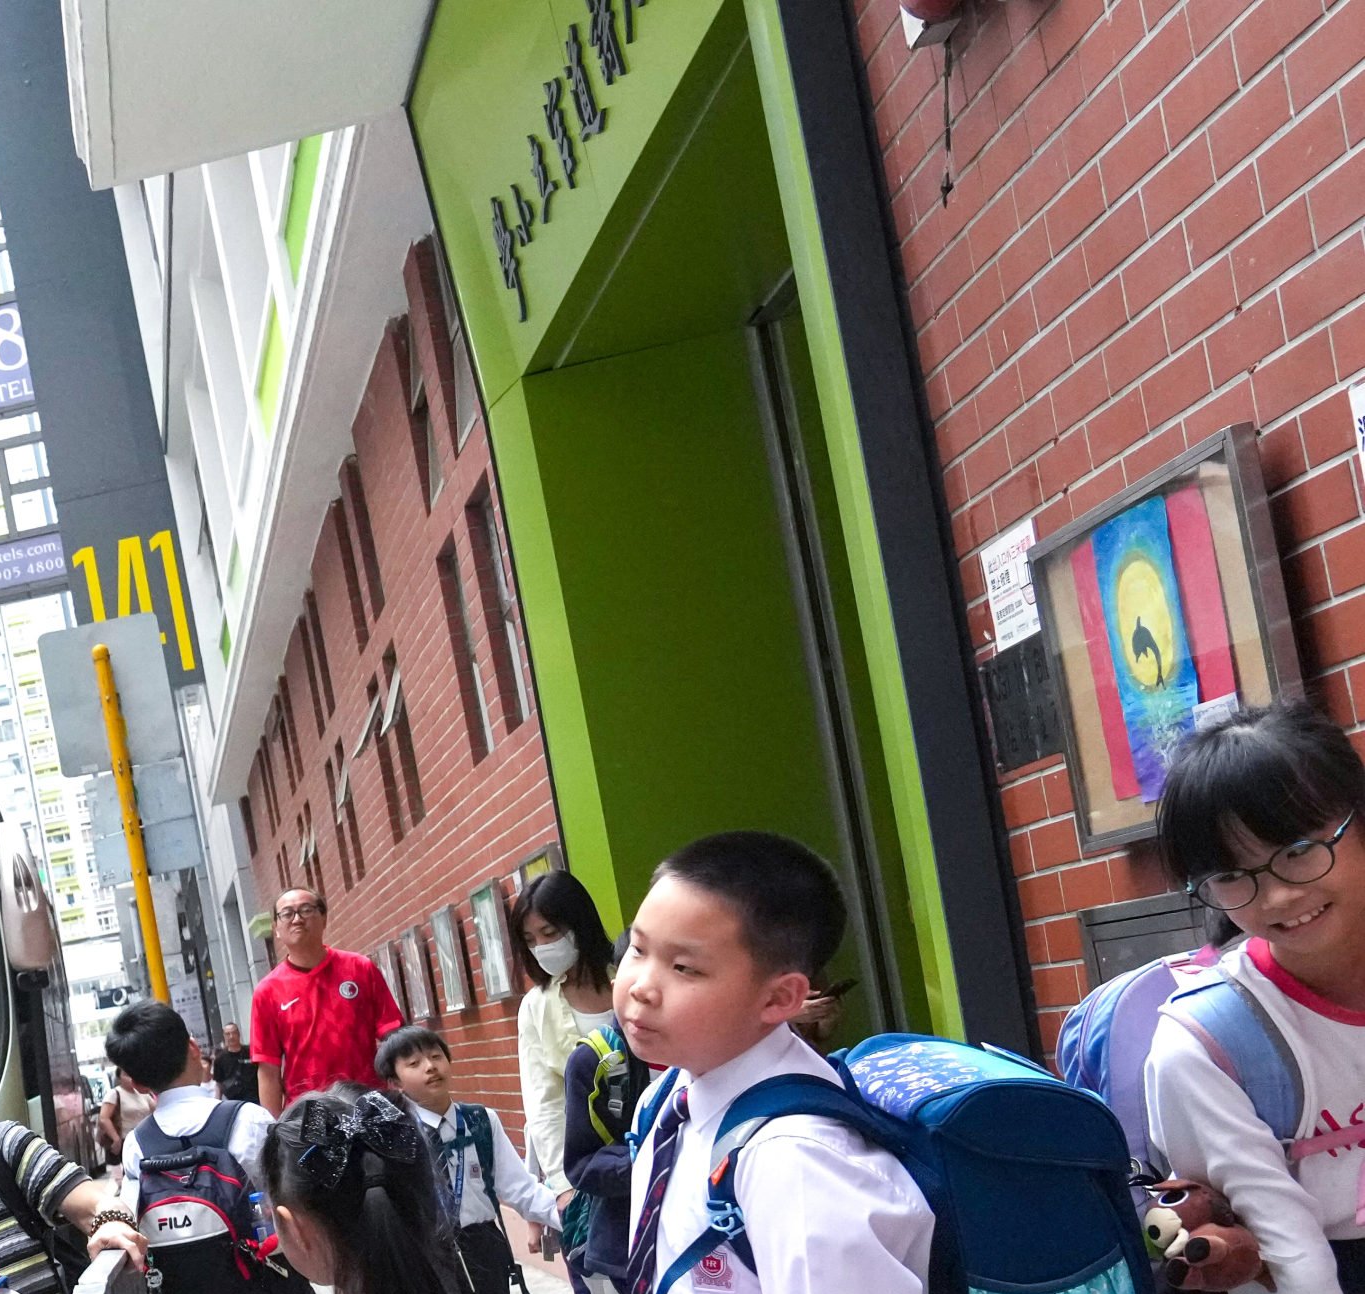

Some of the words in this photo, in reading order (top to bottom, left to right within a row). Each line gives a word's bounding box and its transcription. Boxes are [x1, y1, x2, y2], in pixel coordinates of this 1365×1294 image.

[26, 556, 65, 576] 4800
[71, 530, 196, 672] 141
[157, 1214, 192, 1231] FILA
